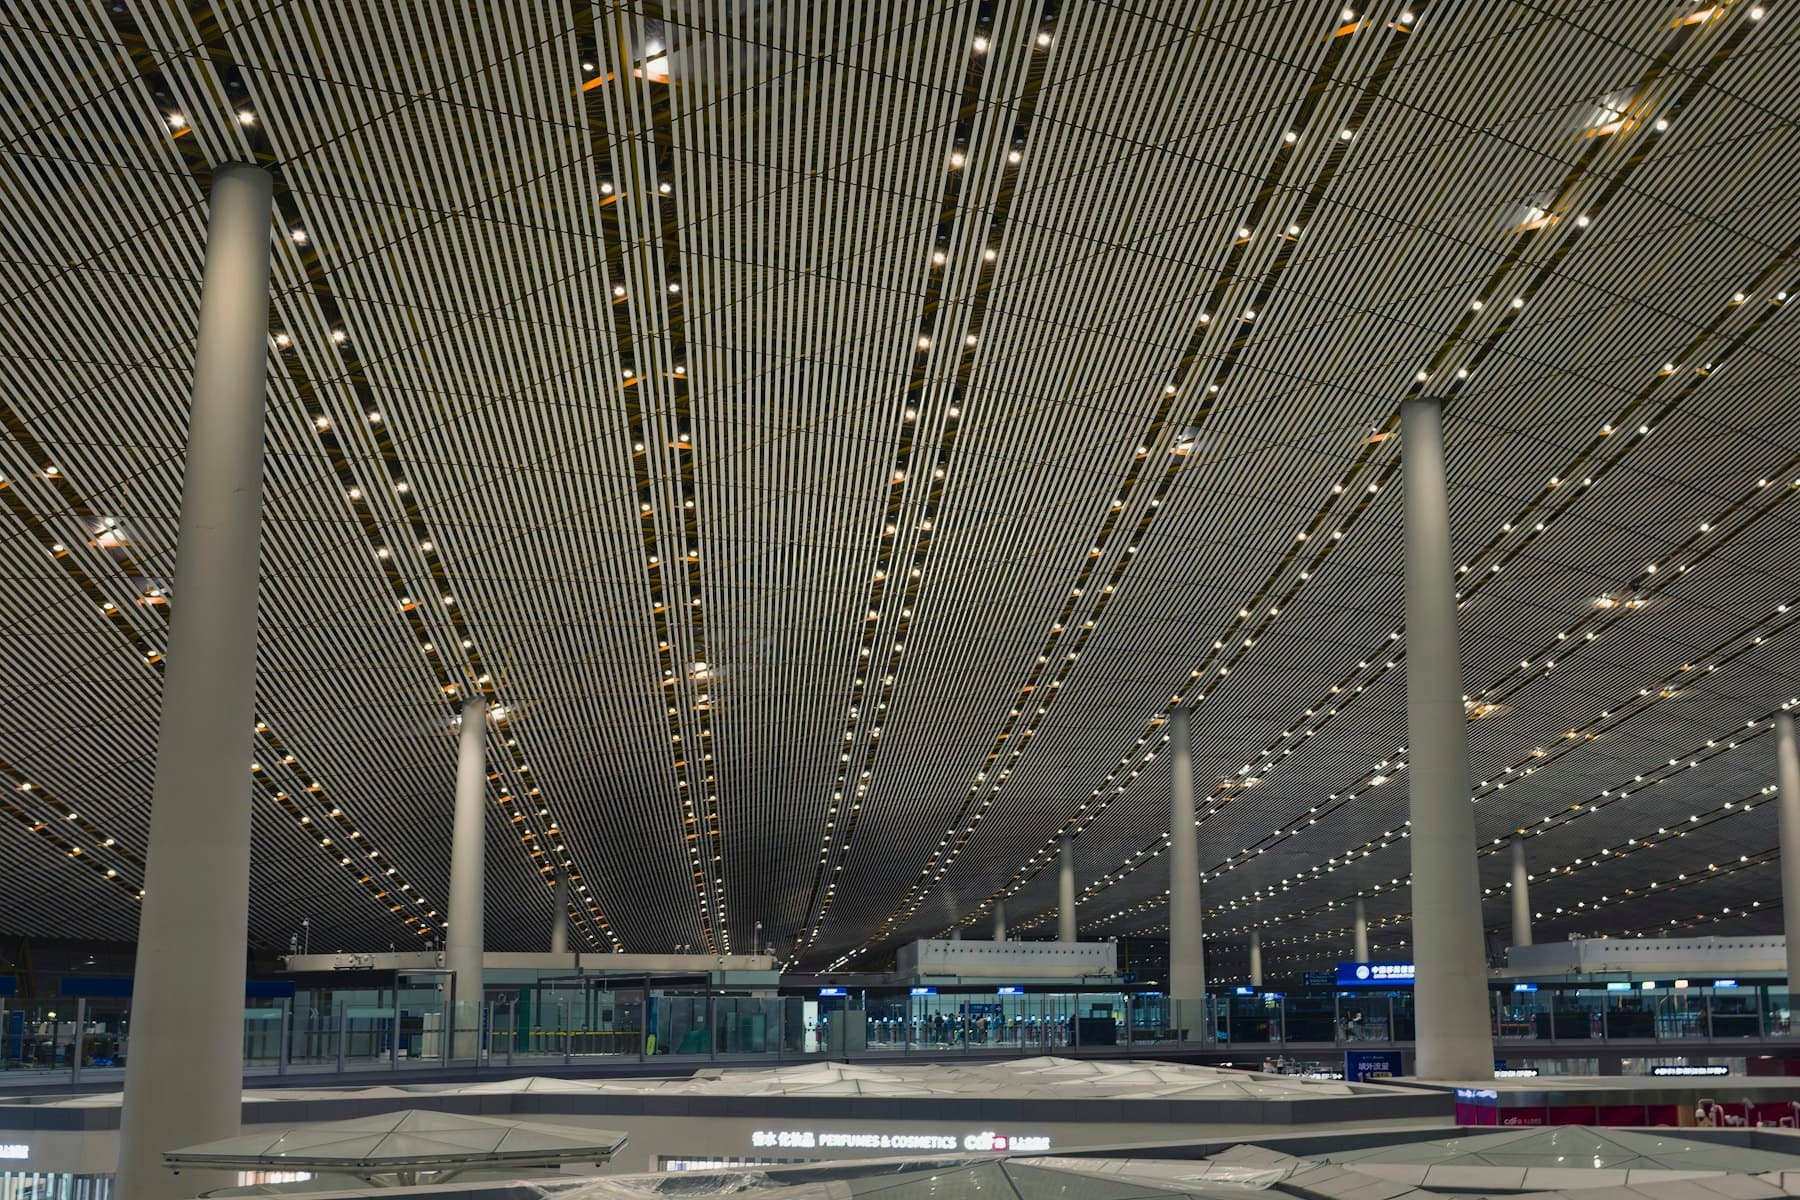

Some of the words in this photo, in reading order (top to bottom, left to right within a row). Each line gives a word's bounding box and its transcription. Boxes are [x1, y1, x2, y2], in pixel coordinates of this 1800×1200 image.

[819, 1134, 880, 1147] PERFUMES
[880, 1135, 890, 1148] &
[891, 1135, 957, 1149] COSMETICS
